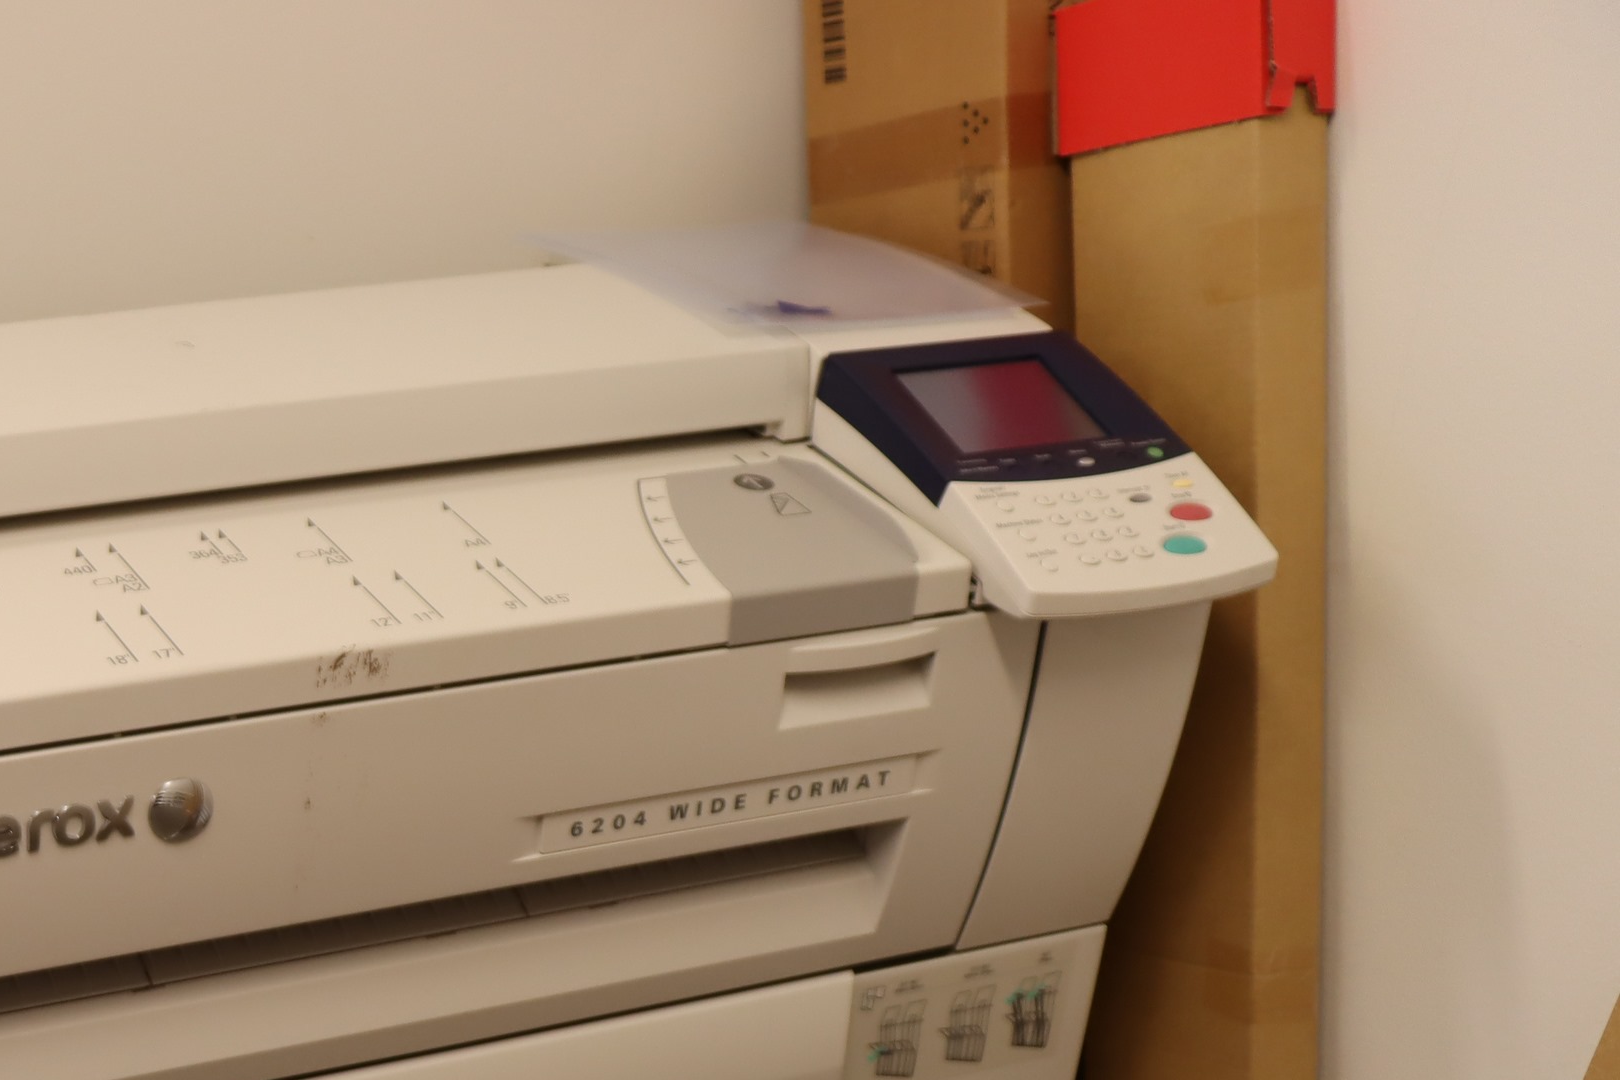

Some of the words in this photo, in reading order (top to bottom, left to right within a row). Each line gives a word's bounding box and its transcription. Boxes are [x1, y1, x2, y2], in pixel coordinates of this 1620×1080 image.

[64, 565, 93, 576] 440
[570, 810, 647, 837] 6204
[668, 793, 747, 821] WIDE
[768, 770, 892, 804] FORMAT
